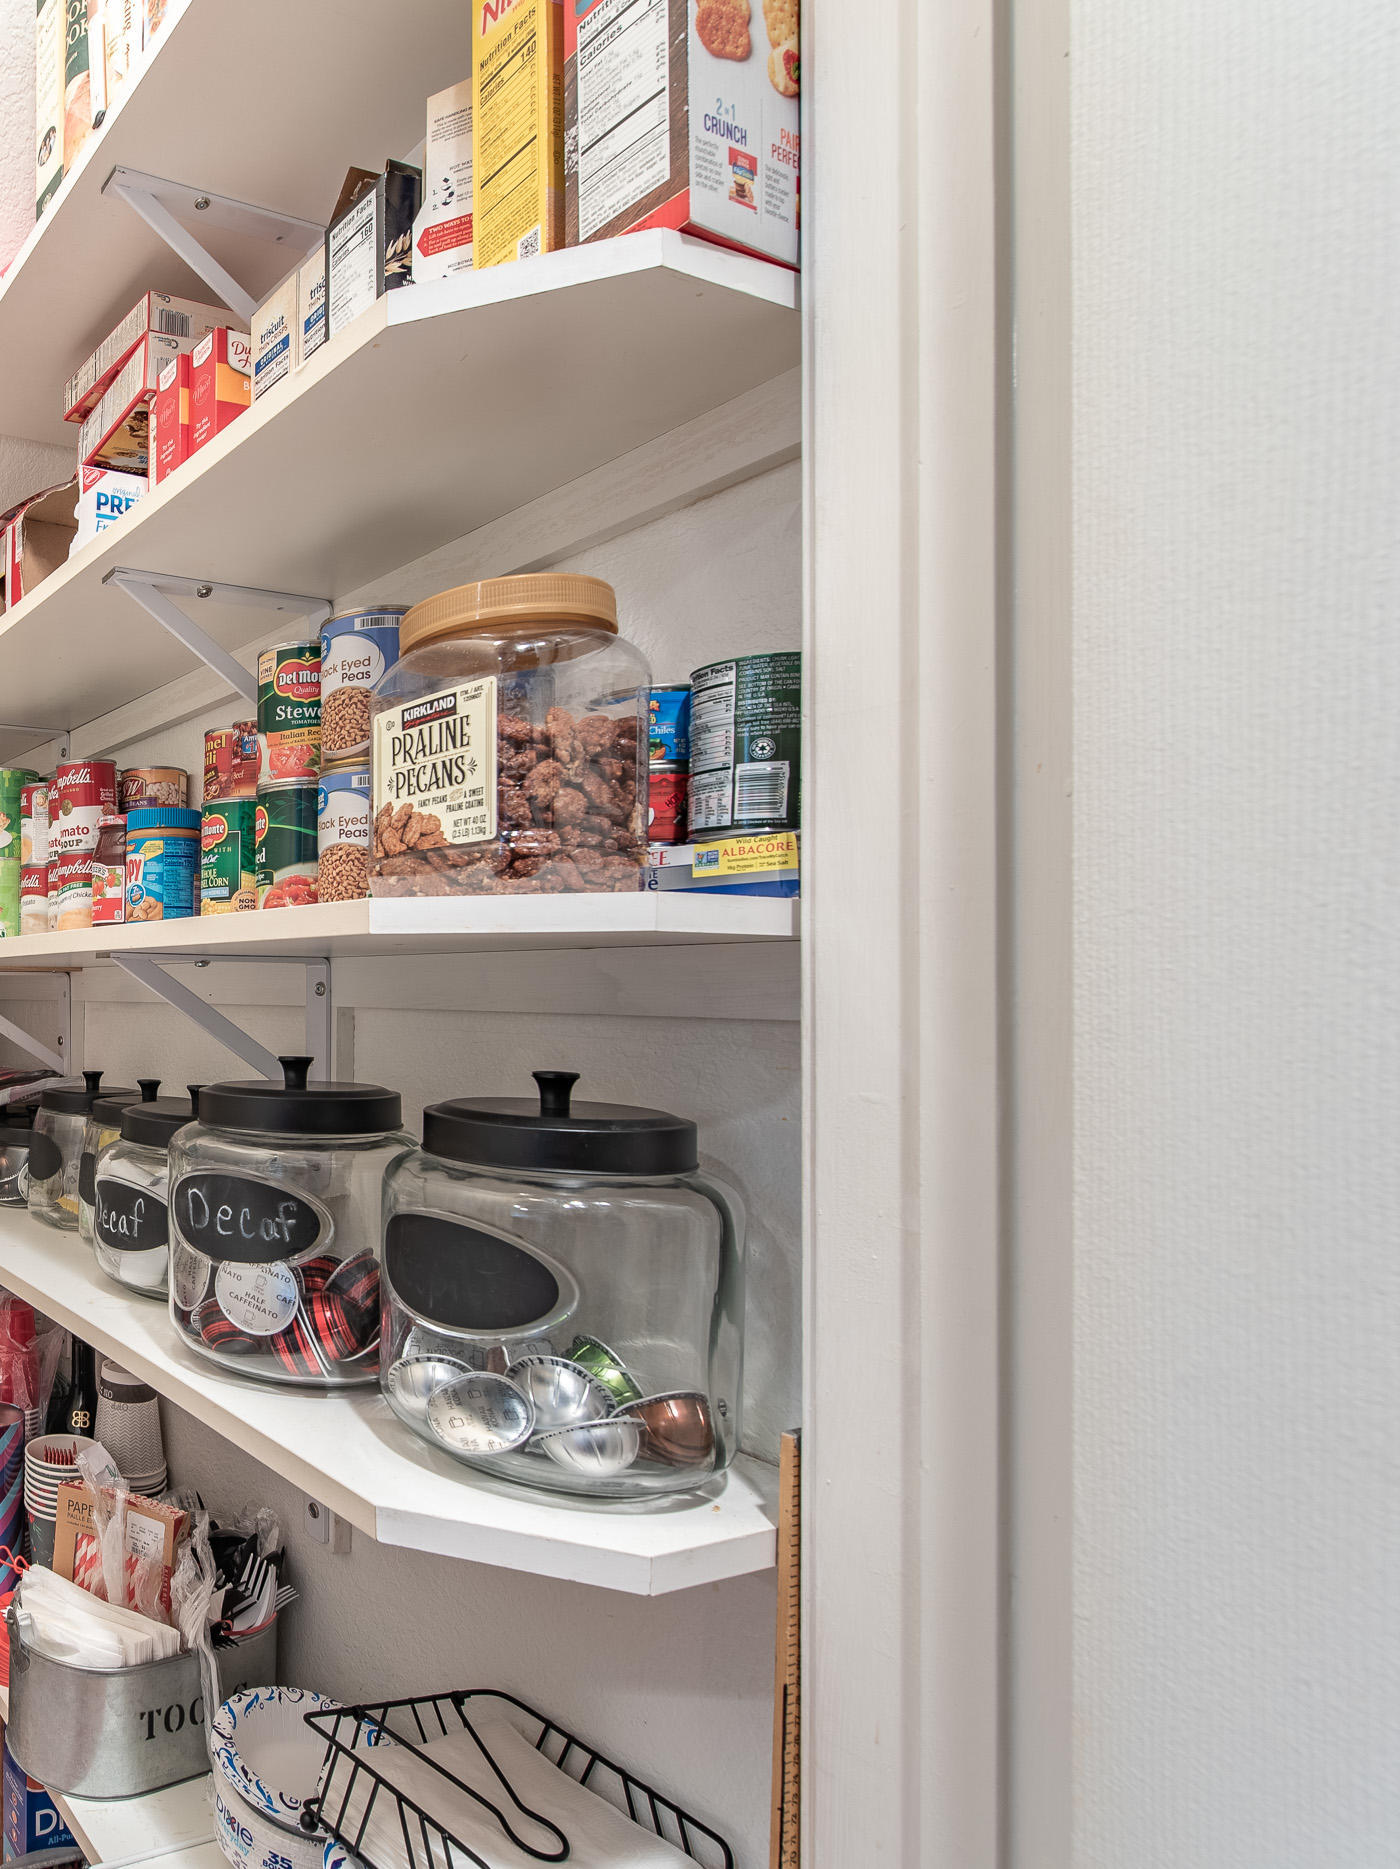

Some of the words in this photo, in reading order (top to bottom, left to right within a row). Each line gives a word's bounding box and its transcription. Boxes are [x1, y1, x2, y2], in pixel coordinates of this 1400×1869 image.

[480, 33, 512, 70] Nutrition
[513, 6, 536, 35] Facts
[580, 25, 623, 66] Calories
[520, 40, 537, 62] 140
[480, 78, 505, 105] Calories
[716, 97, 723, 116] 2
[704, 113, 747, 147] CRUNCH
[772, 144, 800, 169] PERFE
[331, 215, 354, 241] Nutrition
[355, 197, 373, 217] Facts
[428, 225, 443, 234] TWO
[443, 219, 461, 229] WAYS
[360, 222, 374, 240] 160
[309, 275, 326, 299] trisc
[260, 314, 285, 345] triscuit
[275, 353, 289, 368] Facts
[96, 492, 135, 514] PRE
[96, 520, 109, 532] Fr
[260, 665, 273, 677] VINE
[341, 656, 371, 673] Eyed
[710, 665, 734, 676] Facts
[278, 671, 298, 687] Del
[341, 670, 371, 684] Peas
[293, 685, 320, 695] Quality
[403, 694, 456, 722] KIRKLAND
[280, 731, 306, 741] Italian
[307, 729, 321, 737] Rec
[649, 726, 676, 735] Chiles
[391, 714, 472, 767] PRALINE
[394, 754, 467, 800] PECANS
[418, 798, 431, 809] FANCY
[432, 794, 448, 806] PECANS
[468, 786, 484, 798] SWEET
[446, 801, 464, 813] PRALINE
[465, 797, 484, 809] COATING
[665, 793, 679, 808] HOT
[338, 813, 369, 831] Eyed
[453, 818, 462, 828] NET
[463, 816, 471, 827] WT
[479, 814, 487, 824] OZ
[338, 827, 369, 839] Peas
[735, 837, 752, 845] Wild
[753, 835, 778, 844] Caught
[722, 841, 795, 858] ALBACORE
[209, 876, 229, 888] CORN
[73, 891, 92, 899] Chicke
[187, 1187, 298, 1243] Decaf
[221, 1267, 243, 1282] NATO
[228, 1290, 279, 1320] CAFFEINATO
[244, 1290, 266, 1306] HALF
[276, 1293, 297, 1307] CAFF
[67, 1499, 95, 1514] PAPE
